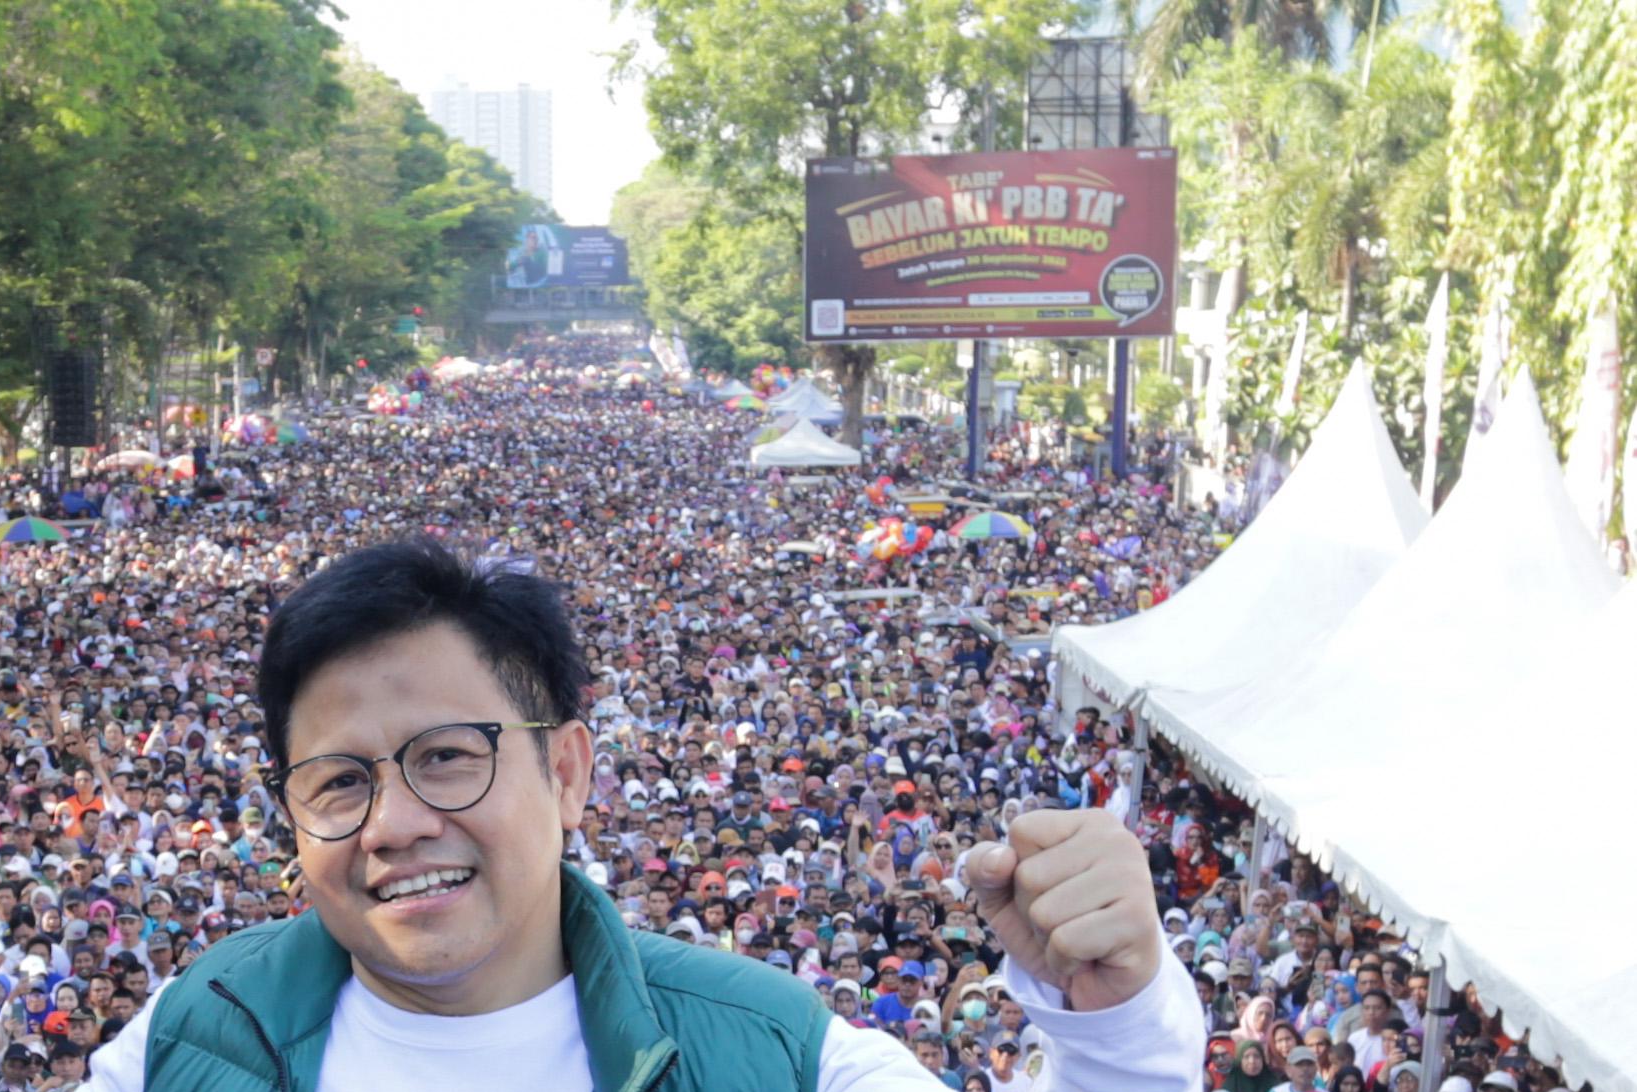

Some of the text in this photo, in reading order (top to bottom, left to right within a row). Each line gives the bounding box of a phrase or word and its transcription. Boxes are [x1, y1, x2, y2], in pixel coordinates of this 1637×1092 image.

[847, 185, 1125, 248] BAYAR KI' PBB TA'
[860, 225, 1108, 269] SEBELUM JATUH TEMPO
